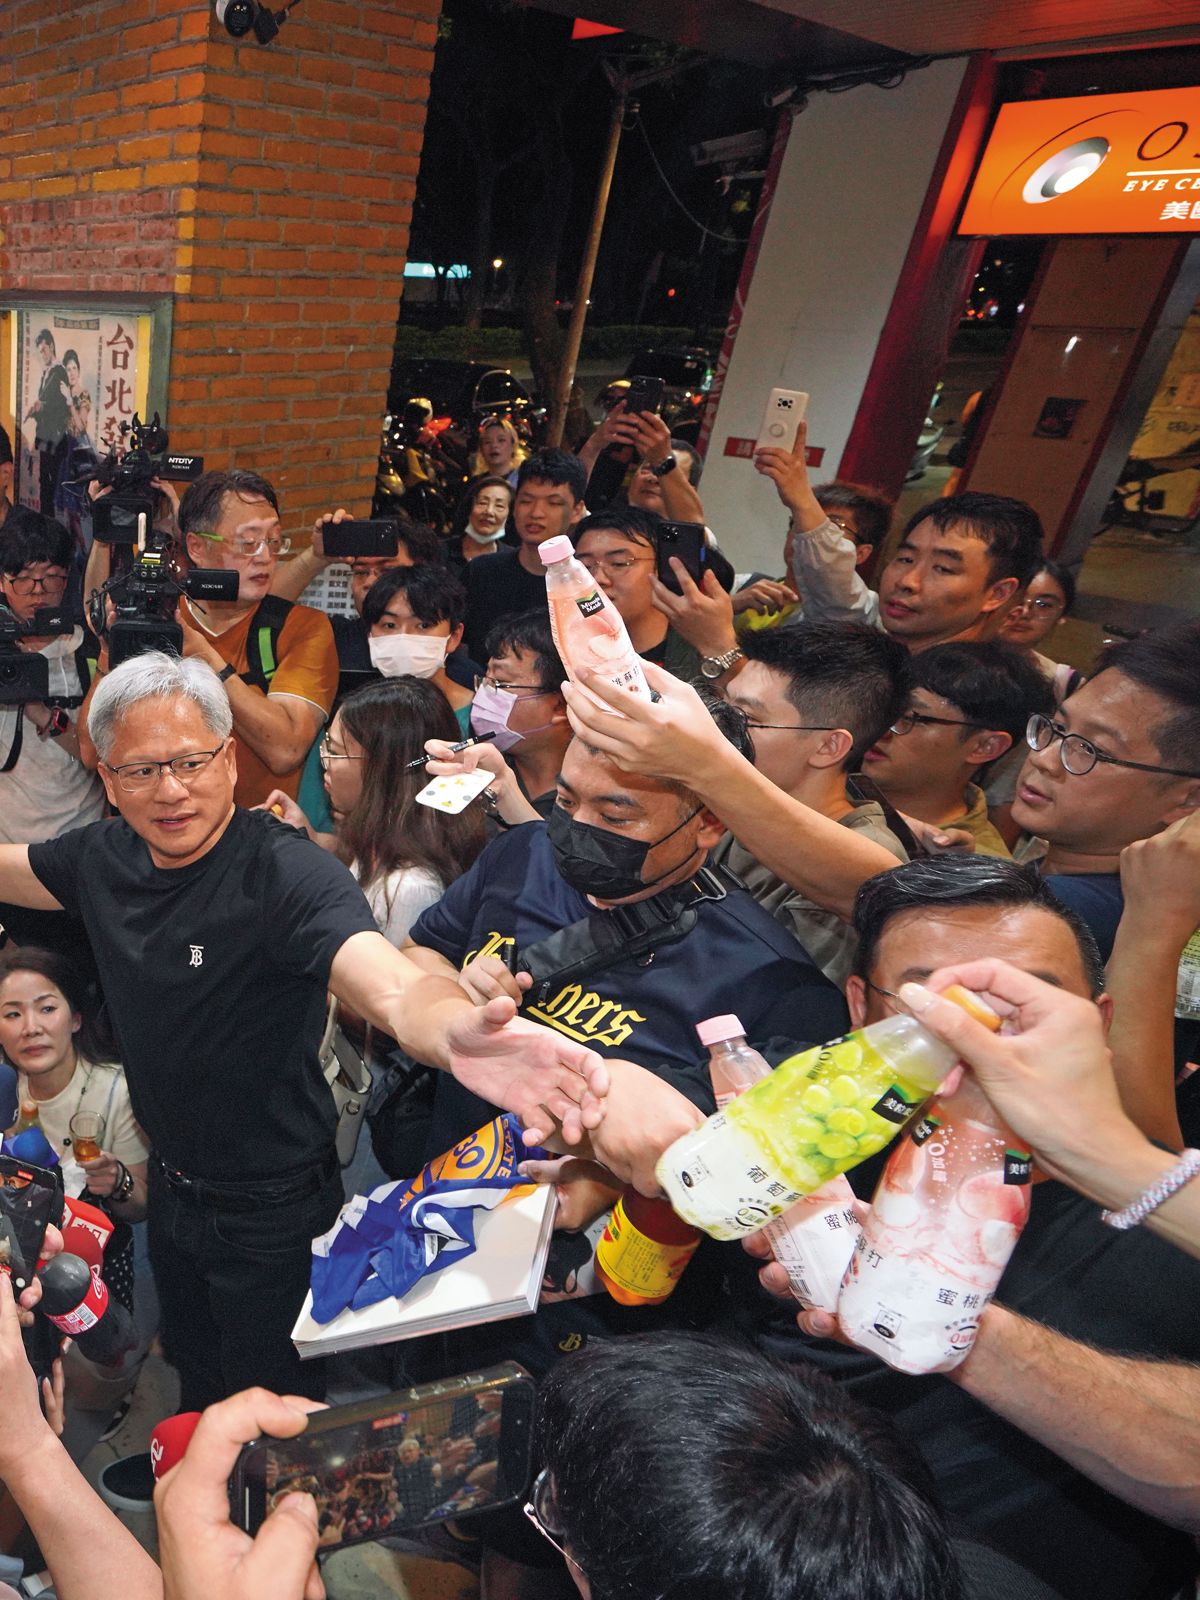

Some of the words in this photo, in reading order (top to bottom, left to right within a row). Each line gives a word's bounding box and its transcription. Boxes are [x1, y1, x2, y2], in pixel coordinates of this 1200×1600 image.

[1122, 179, 1169, 192] EYE
[168, 457, 194, 465] NTDTV
[538, 983, 648, 1047] ners
[453, 1133, 486, 1170] 30
[498, 1118, 516, 1179] STATE
